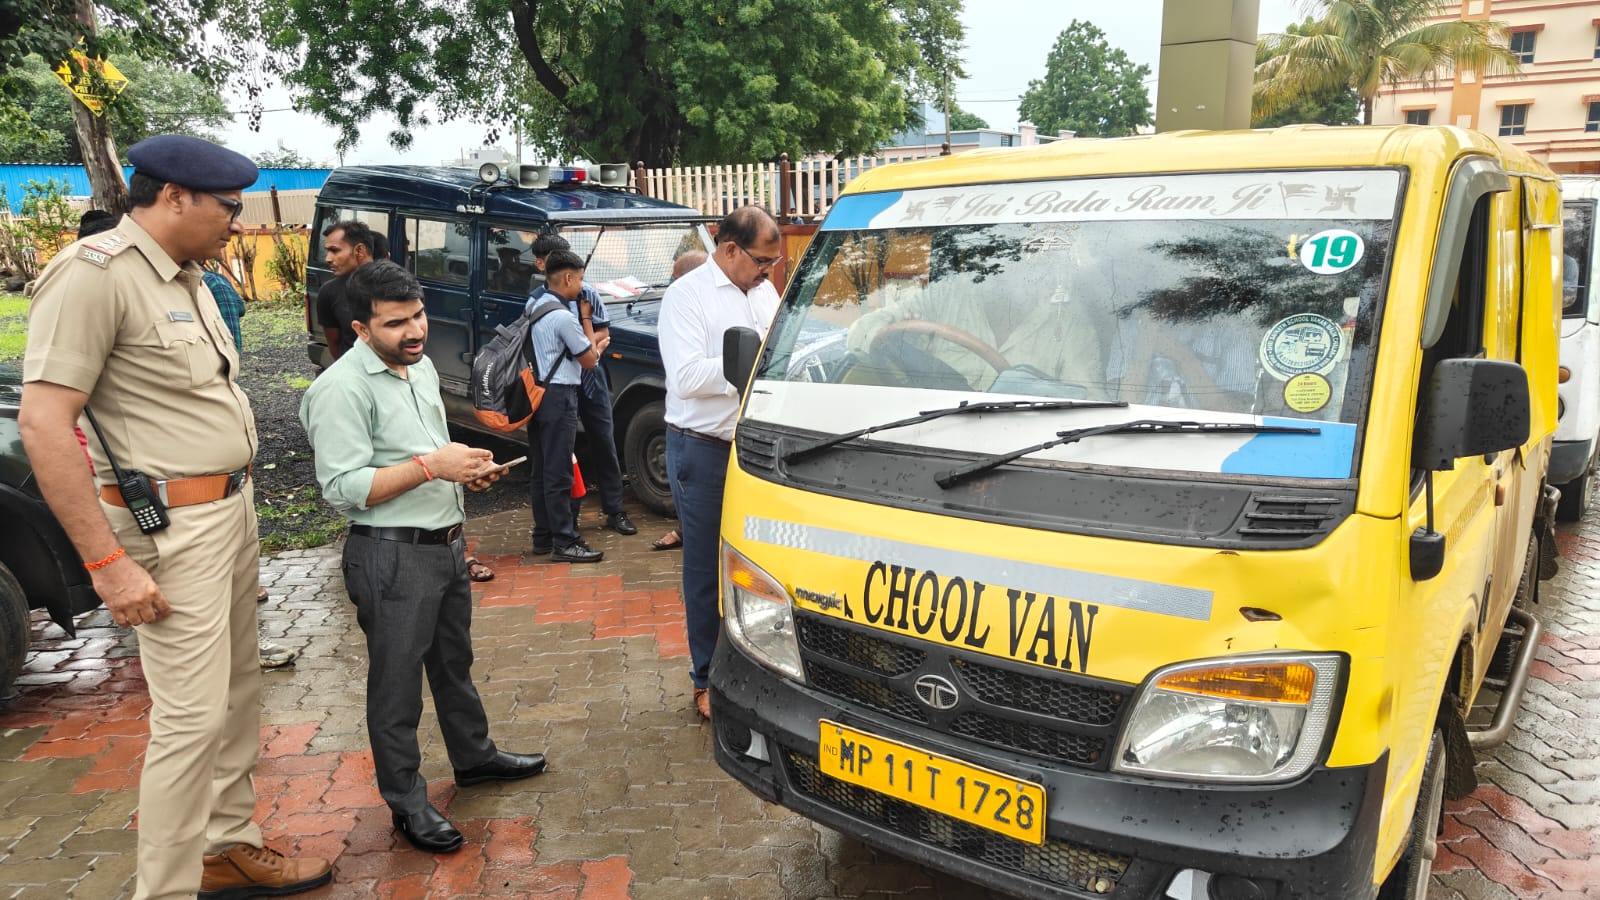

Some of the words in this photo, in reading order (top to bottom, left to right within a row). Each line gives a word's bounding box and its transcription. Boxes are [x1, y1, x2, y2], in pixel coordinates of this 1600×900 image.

[956, 193, 1008, 222] Jai
[1015, 190, 1109, 217] Bala
[1114, 185, 1219, 213] Ram
[1209, 184, 1271, 216] Ji
[1310, 236, 1358, 268] 19
[795, 587, 842, 610] magic
[845, 561, 990, 648] CHOOL
[1006, 588, 1098, 674] VAN
[823, 743, 838, 756] IND
[840, 738, 872, 776] MP
[885, 754, 913, 792] 11
[926, 766, 941, 800] T
[956, 777, 1034, 830] 1728
